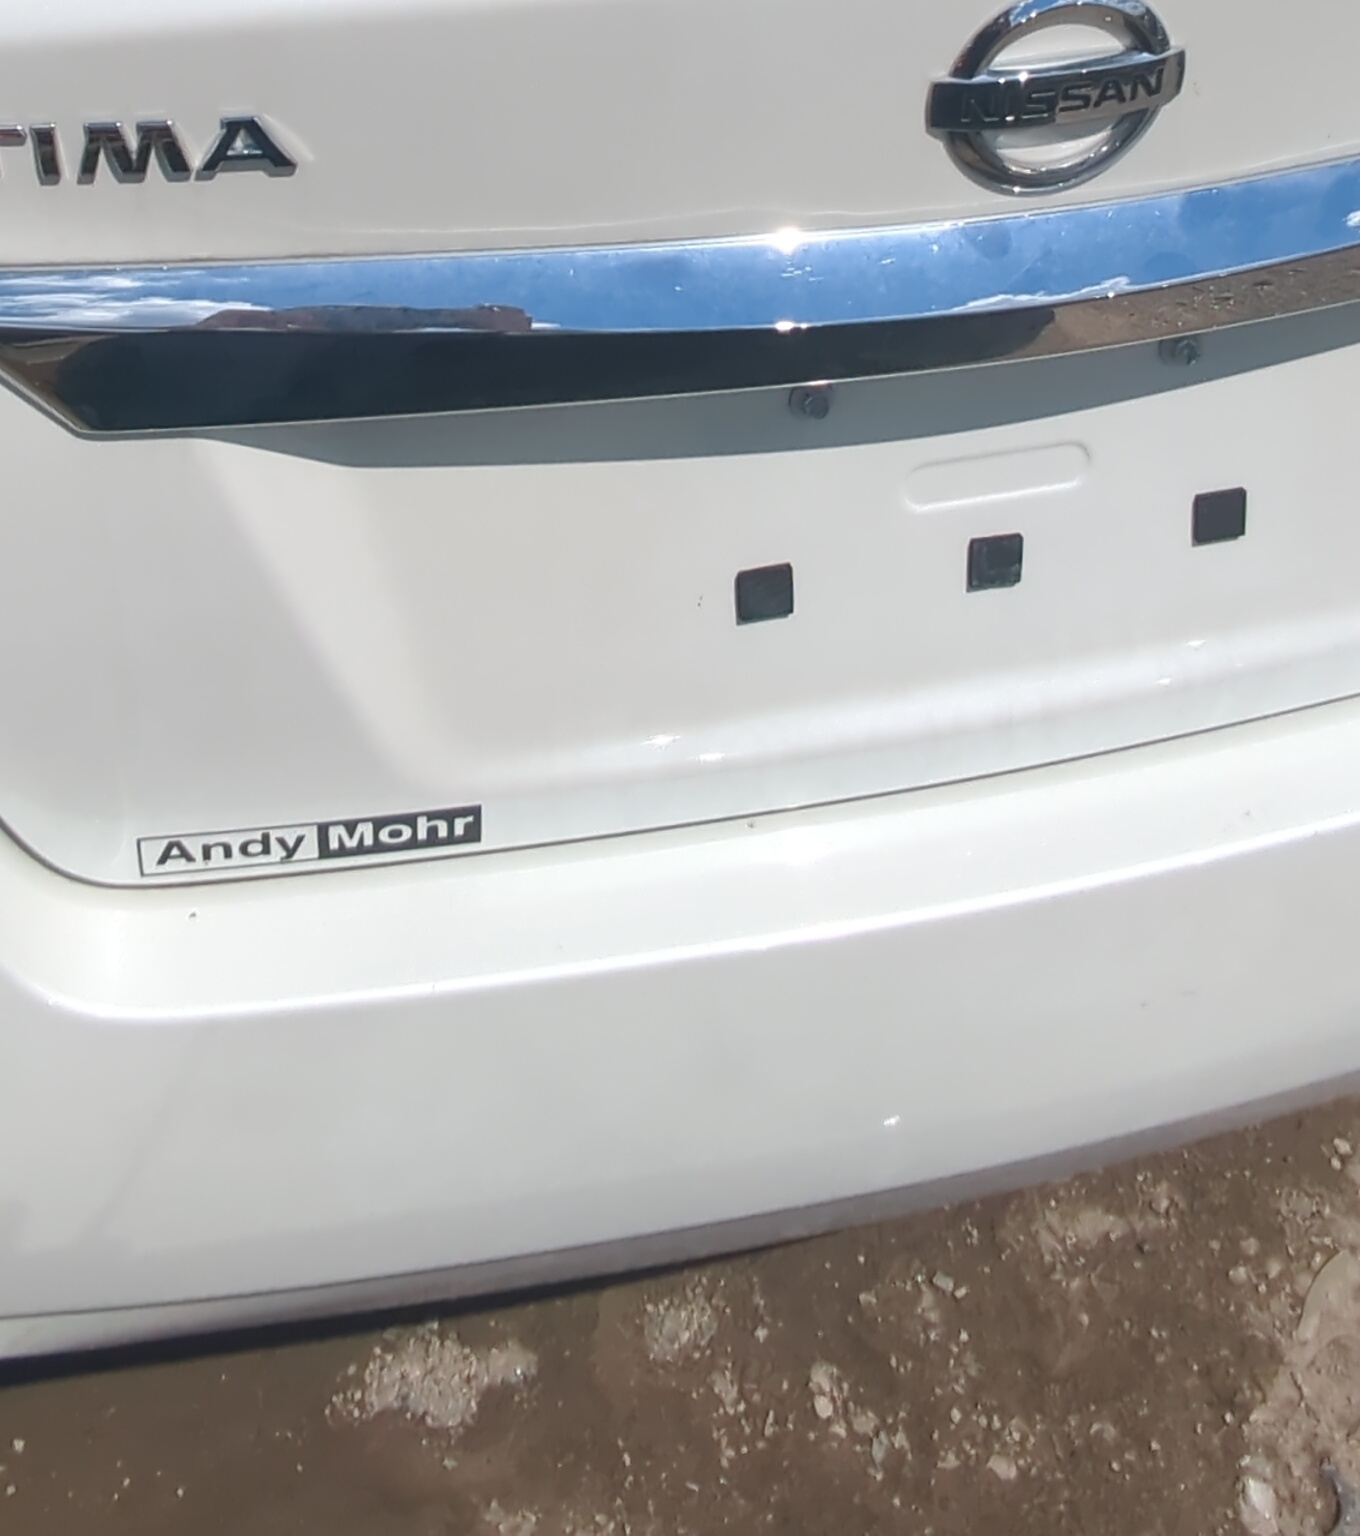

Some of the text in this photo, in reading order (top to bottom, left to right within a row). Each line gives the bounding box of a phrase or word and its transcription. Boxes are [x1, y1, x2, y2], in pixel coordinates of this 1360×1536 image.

[959, 67, 1165, 123] NISSAN
[155, 814, 475, 865] Andy Mohr
